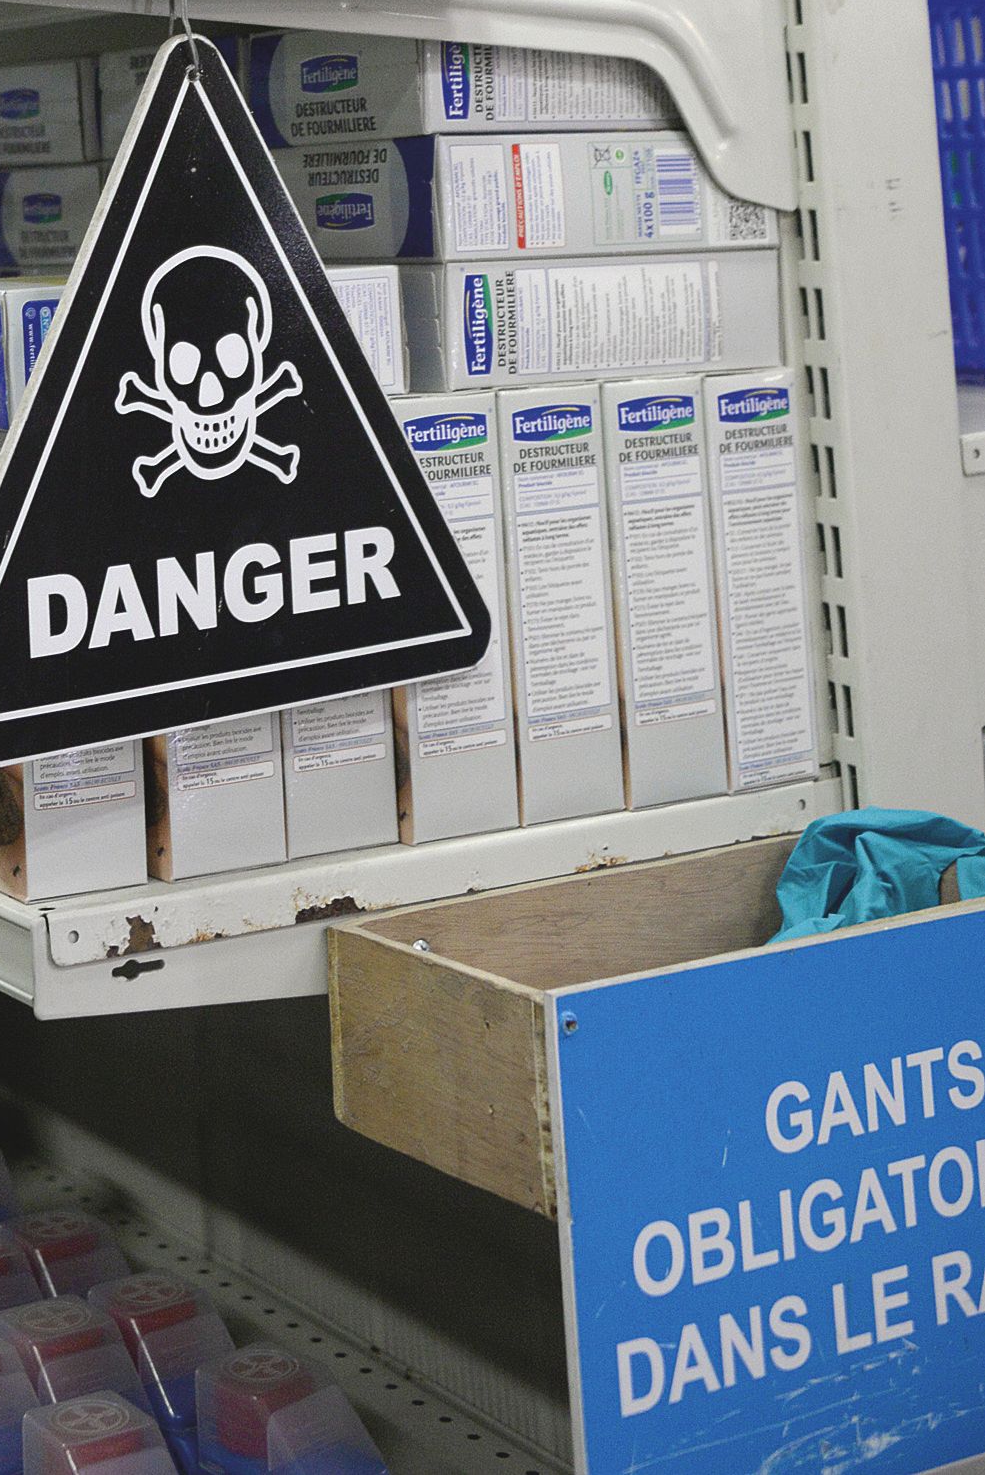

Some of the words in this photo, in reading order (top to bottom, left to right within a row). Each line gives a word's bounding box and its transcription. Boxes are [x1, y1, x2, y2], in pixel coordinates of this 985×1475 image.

[449, 44, 466, 117] Fertiligè
[474, 43, 484, 113] DESTRUCTE
[484, 44, 494, 101] FOURMIL
[295, 97, 368, 119] DESTRUCTEUR
[291, 123, 305, 137] DE
[307, 116, 377, 136] FOURMILIERE
[496, 279, 506, 367] DESTRUCTEUR
[505, 270, 516, 355] FOURMILIERE
[471, 277, 489, 372] Fertiligène
[508, 360, 517, 374] DE
[620, 404, 693, 424] Fertiligène
[720, 395, 788, 416] Fertiligène
[406, 423, 486, 444] Fertiligène
[515, 413, 591, 434] Fertiligène
[725, 423, 787, 440] DESTRUCTEUR
[519, 442, 589, 459] DESTRUCTEUR
[624, 432, 692, 449] DESTRUCTEUR
[719, 442, 732, 454] DE
[419, 452, 484, 468] ESTRUCTEUR
[513, 461, 527, 473] DE
[530, 454, 596, 472] FOURMILIERE
[619, 451, 632, 463] DE
[635, 444, 700, 461] FOURMILIERE
[424, 464, 492, 481] OURMILIERE
[27, 526, 401, 659] DANGER
[765, 1039, 985, 1154] GANTS
[616, 1295, 813, 1418] DANS
[832, 1266, 914, 1356] LE
[931, 1250, 985, 1326] R
